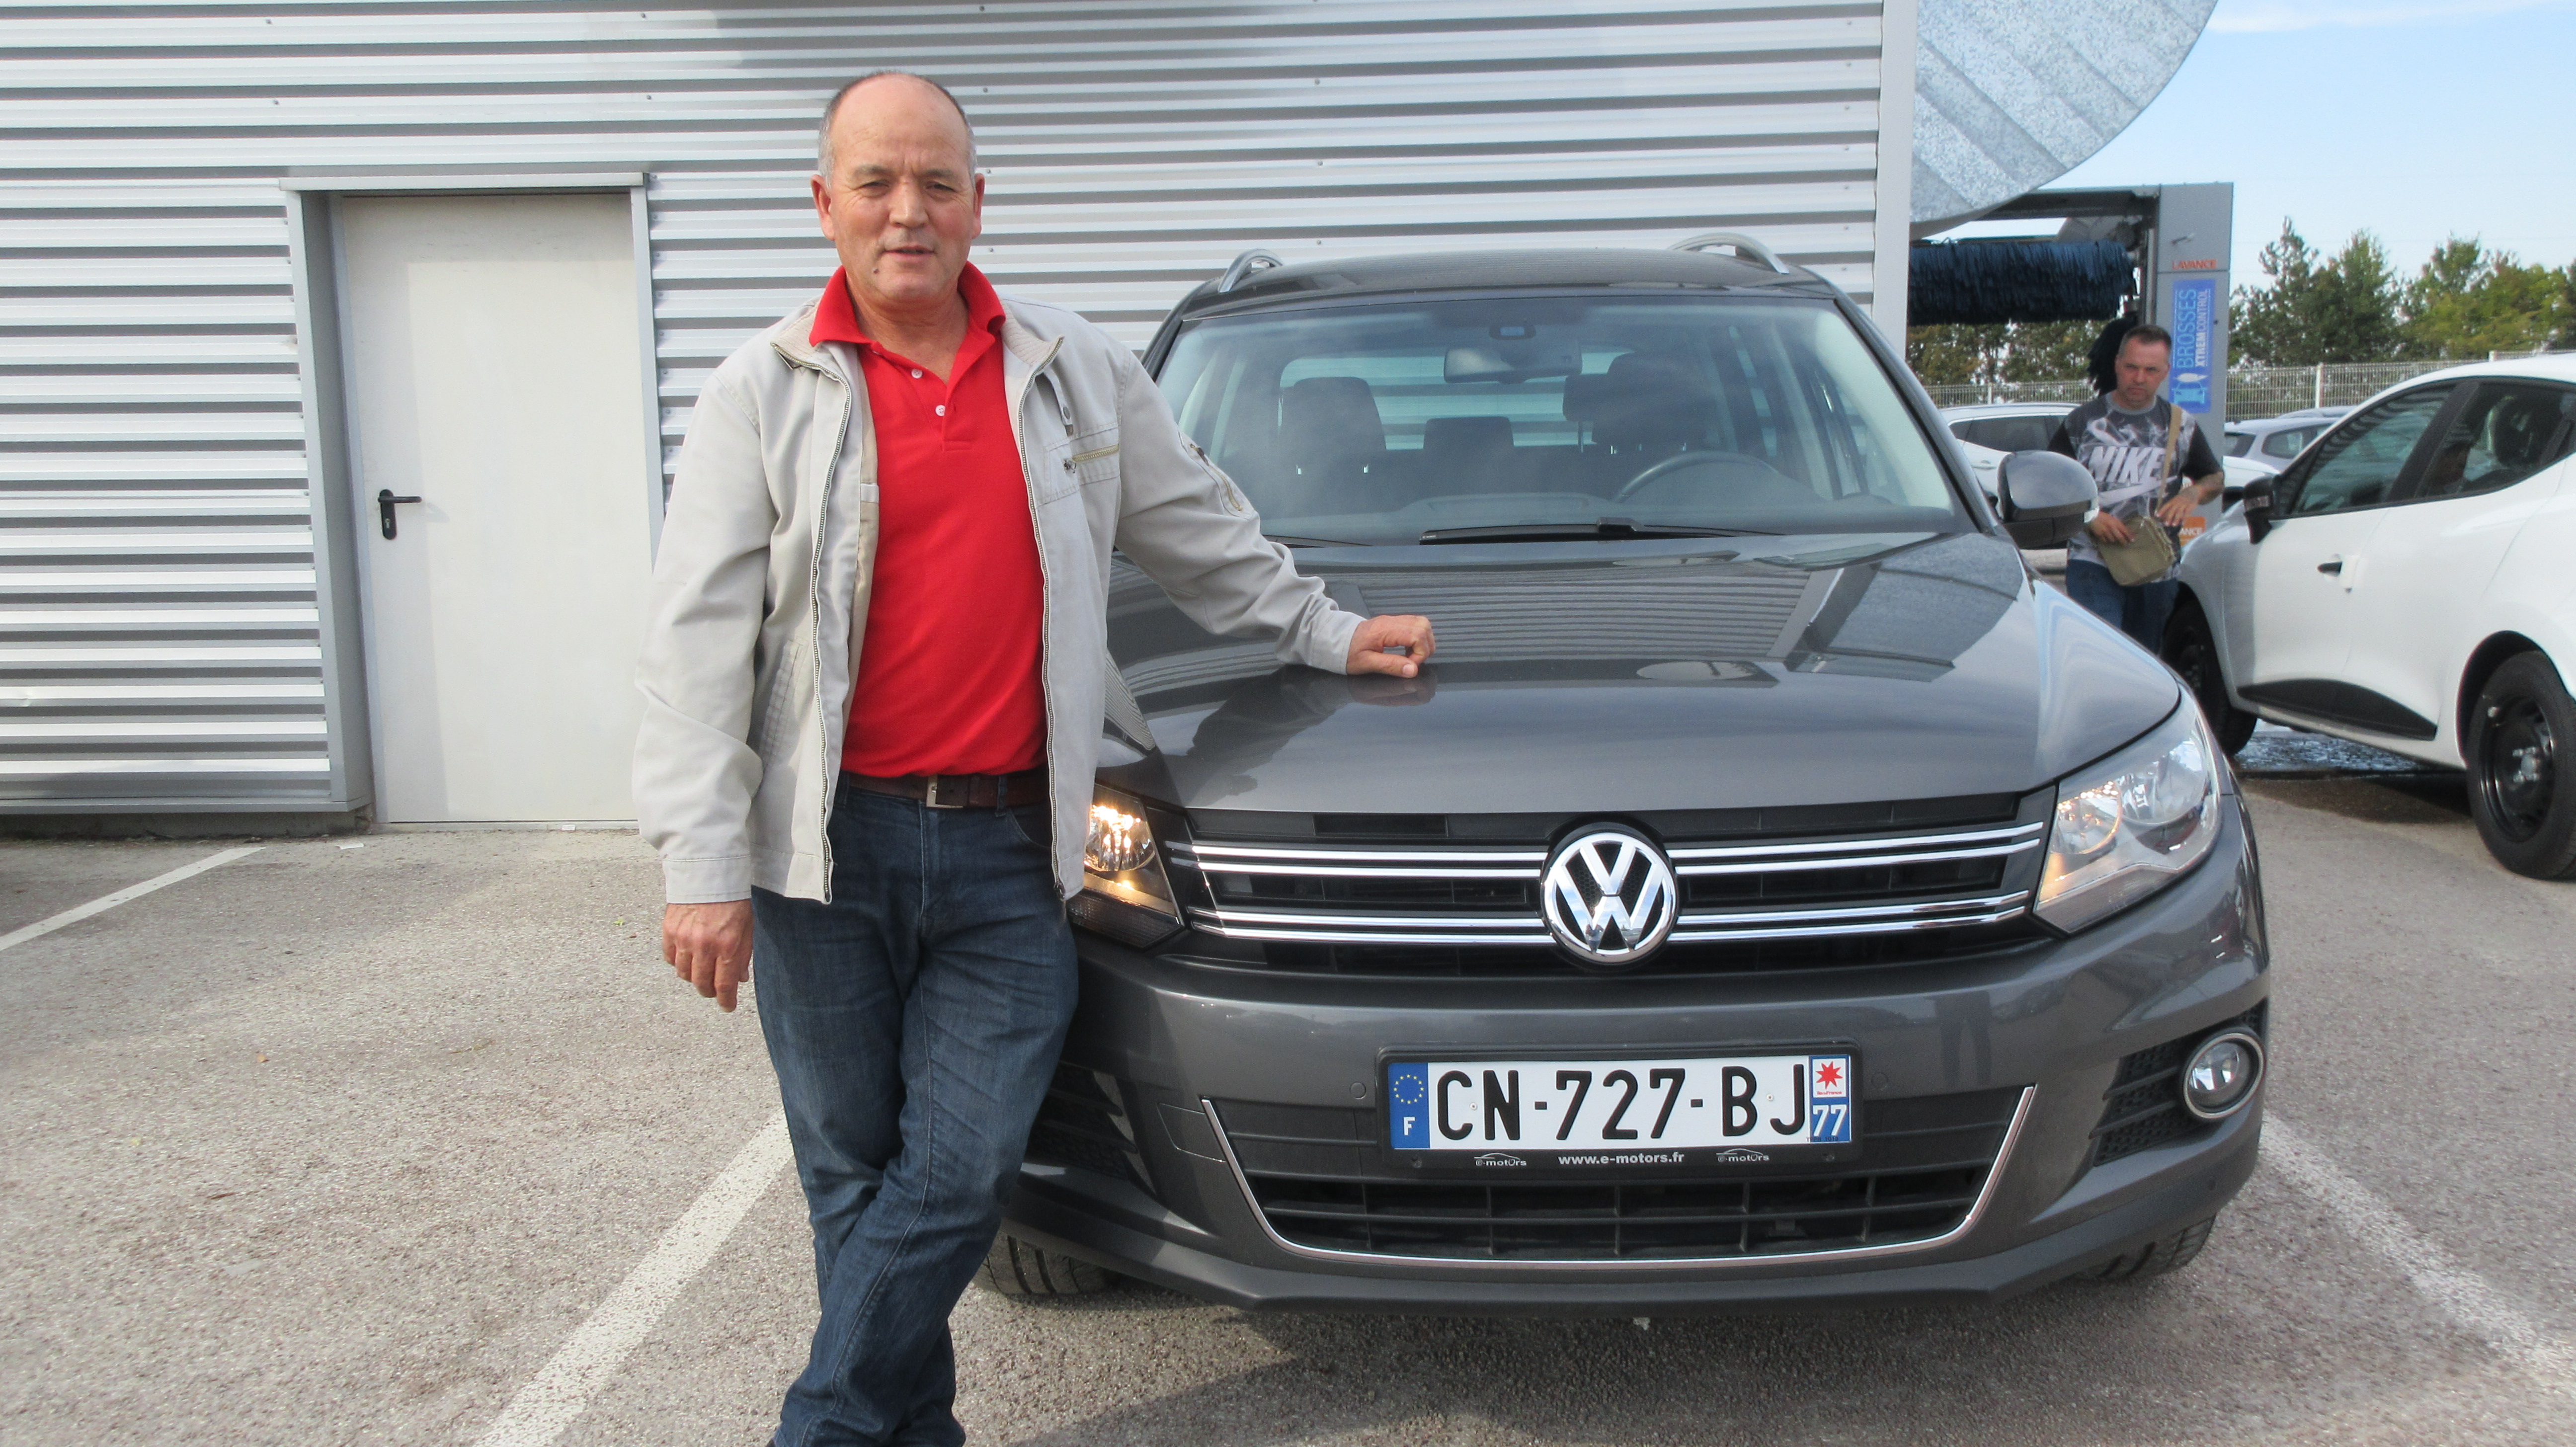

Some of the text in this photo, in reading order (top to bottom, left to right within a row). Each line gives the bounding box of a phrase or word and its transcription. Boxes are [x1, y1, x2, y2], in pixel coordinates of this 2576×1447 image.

[2172, 259, 2217, 270] LAVANCE
[2176, 289, 2197, 369] BROSSES
[2088, 446, 2166, 483] NIKE
[1438, 1063, 1805, 1140] CN-727-BJ
[1403, 1116, 1415, 1136] F
[1813, 1104, 1847, 1136] 77
[1557, 1151, 1685, 1164] www.e-motors.fr
